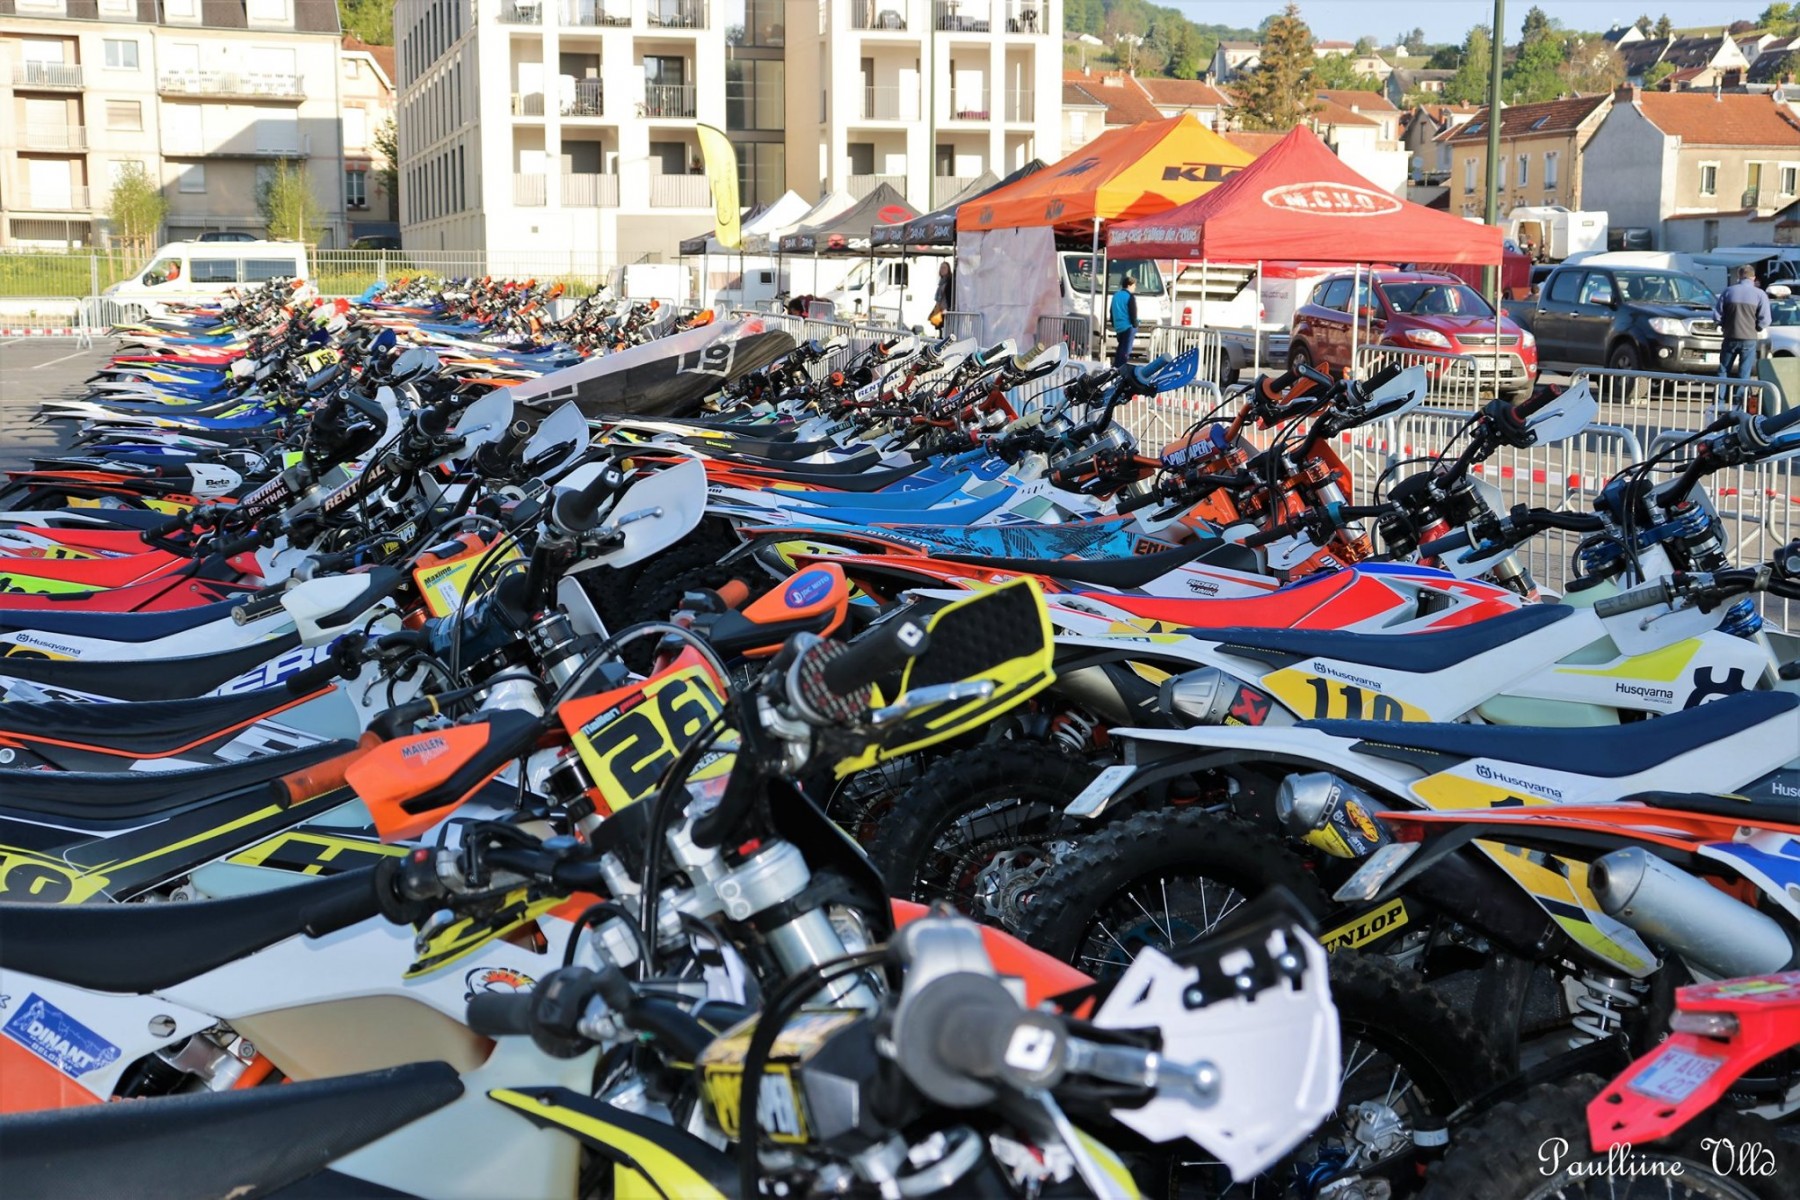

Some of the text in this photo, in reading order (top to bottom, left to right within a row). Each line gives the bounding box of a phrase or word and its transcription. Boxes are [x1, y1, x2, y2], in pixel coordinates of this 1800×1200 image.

[205, 478, 231, 487] Beta
[424, 566, 452, 586] Maxime
[28, 637, 82, 655] Husqvarna
[1327, 667, 1382, 689] Husqvarna
[1615, 682, 1674, 700] Husqvarna
[402, 737, 445, 758] MAILLEN
[1494, 770, 1563, 799] Husqvarna
[1325, 905, 1403, 954] UNLOP
[26, 1020, 95, 1069] DINANT
[30, 1042, 73, 1072] BELGIUM
